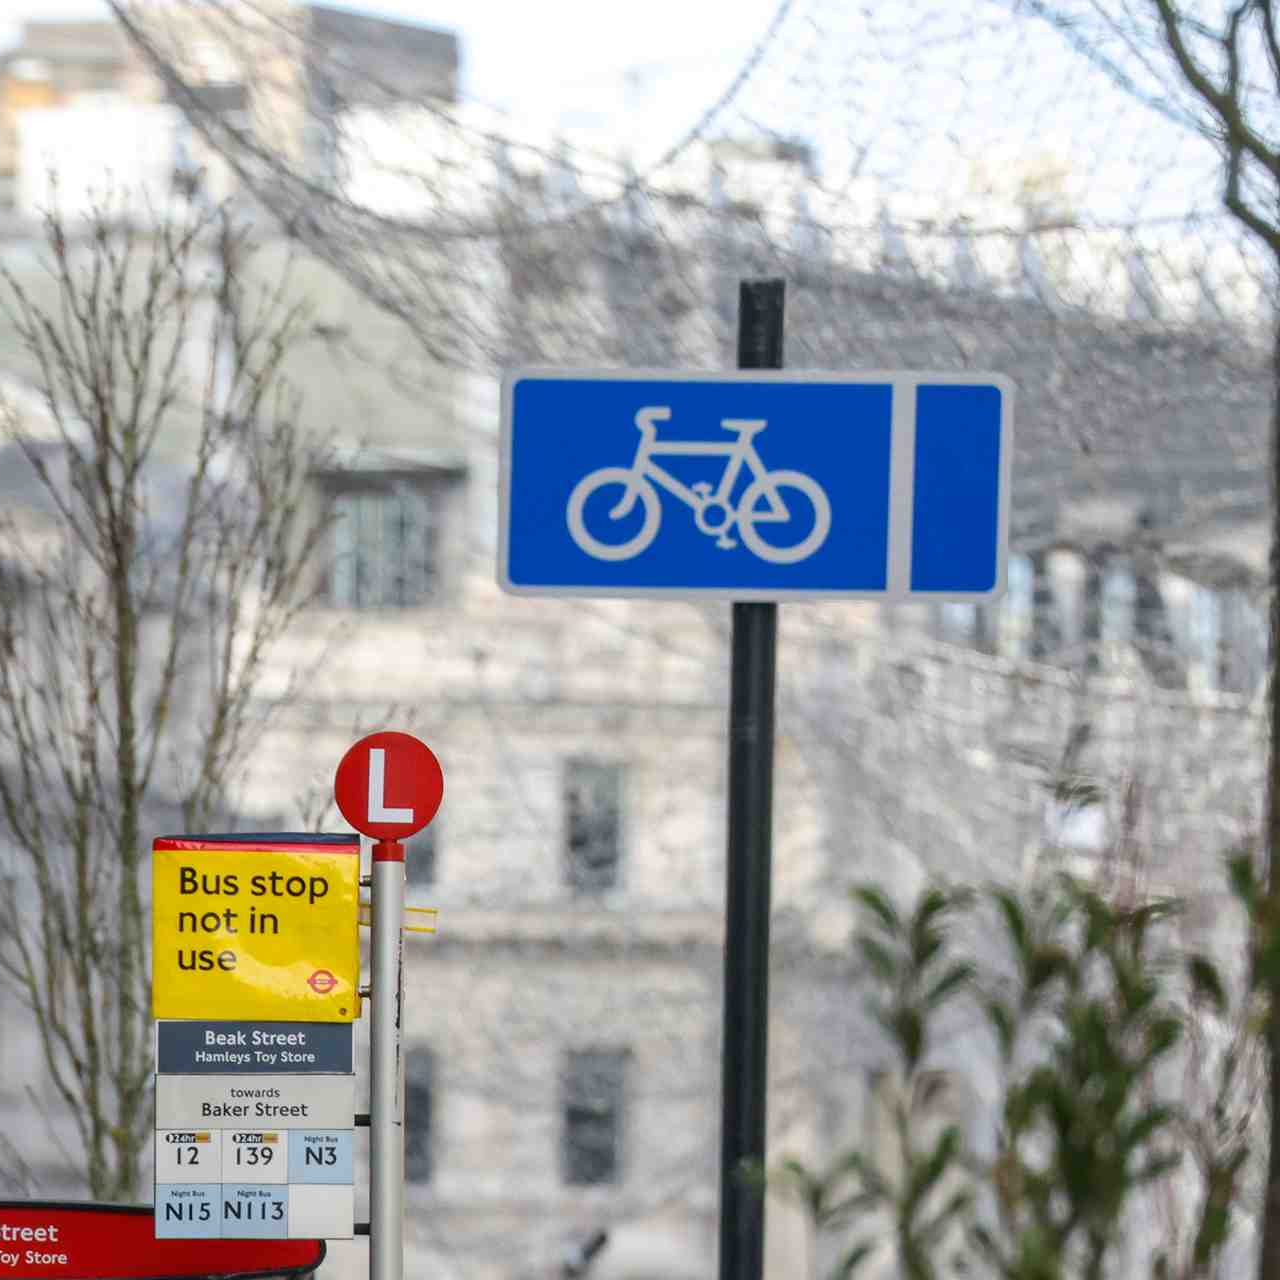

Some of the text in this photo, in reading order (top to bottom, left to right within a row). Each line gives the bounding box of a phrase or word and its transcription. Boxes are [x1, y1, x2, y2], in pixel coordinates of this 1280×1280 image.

[368, 748, 414, 823] L
[179, 866, 328, 904] Bus stop
[178, 906, 278, 934] not in
[178, 950, 237, 971] use
[205, 1030, 306, 1046] Beak Street
[195, 1051, 316, 1064] Hamleys Toy Store
[230, 1088, 281, 1098] towards
[201, 1102, 308, 1117] Baker Street
[176, 1147, 200, 1165] 12
[236, 1147, 273, 1165] 139
[305, 1147, 337, 1165] N3
[166, 1203, 210, 1221] N15
[224, 1201, 284, 1220] N113
[25, 1250, 68, 1264] Store
